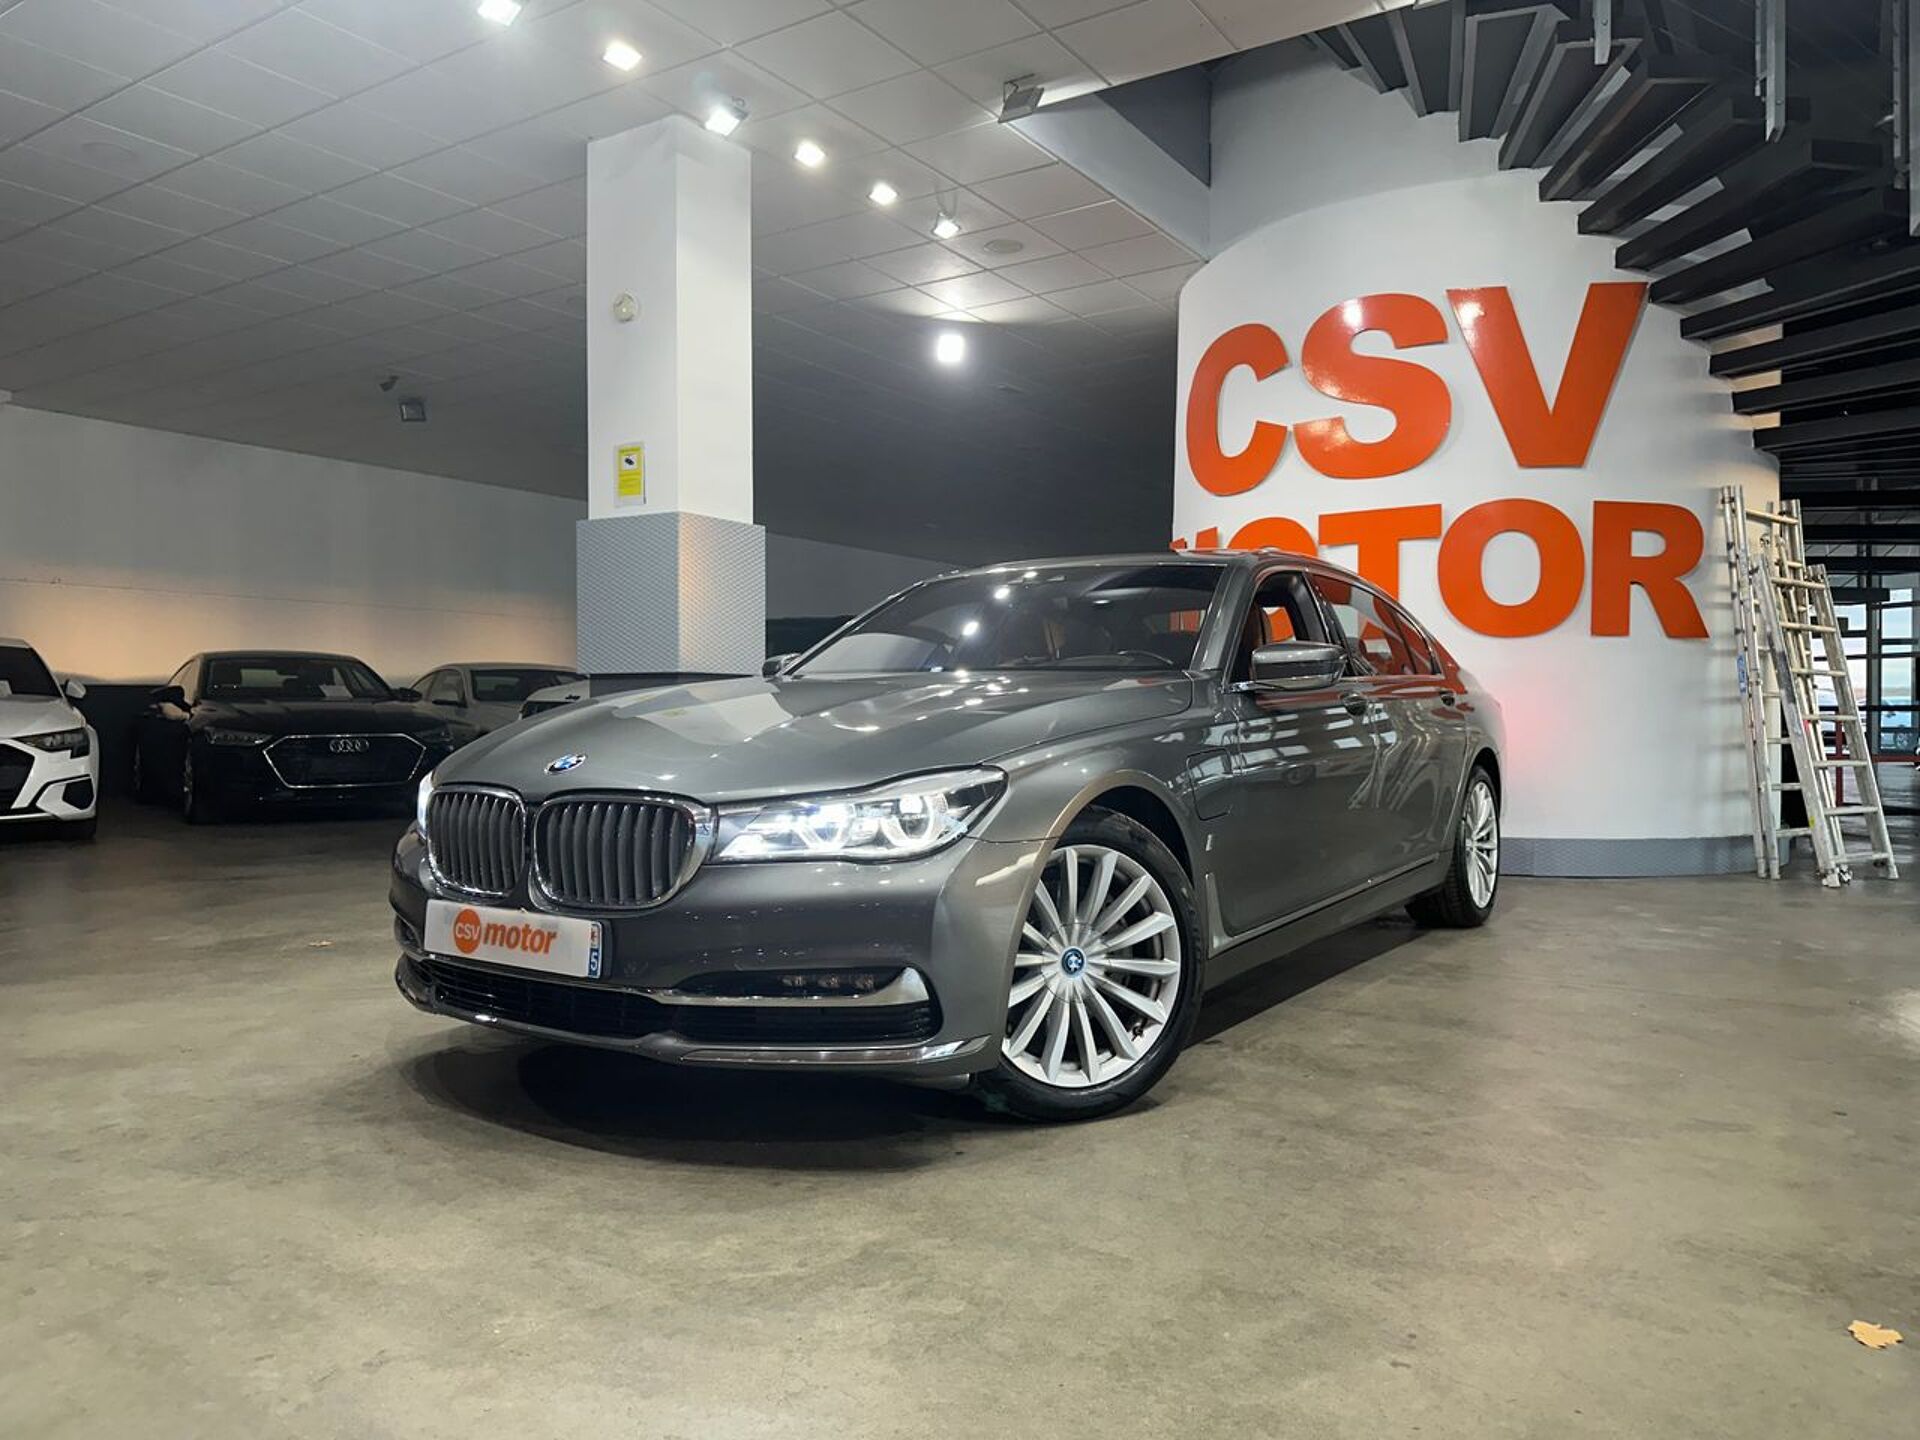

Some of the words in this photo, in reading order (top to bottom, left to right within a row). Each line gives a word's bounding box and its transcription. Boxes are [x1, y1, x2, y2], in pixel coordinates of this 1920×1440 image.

[1186, 281, 1649, 497] CSV
[1169, 498, 1710, 639] TOR
[483, 922, 557, 954] motor
